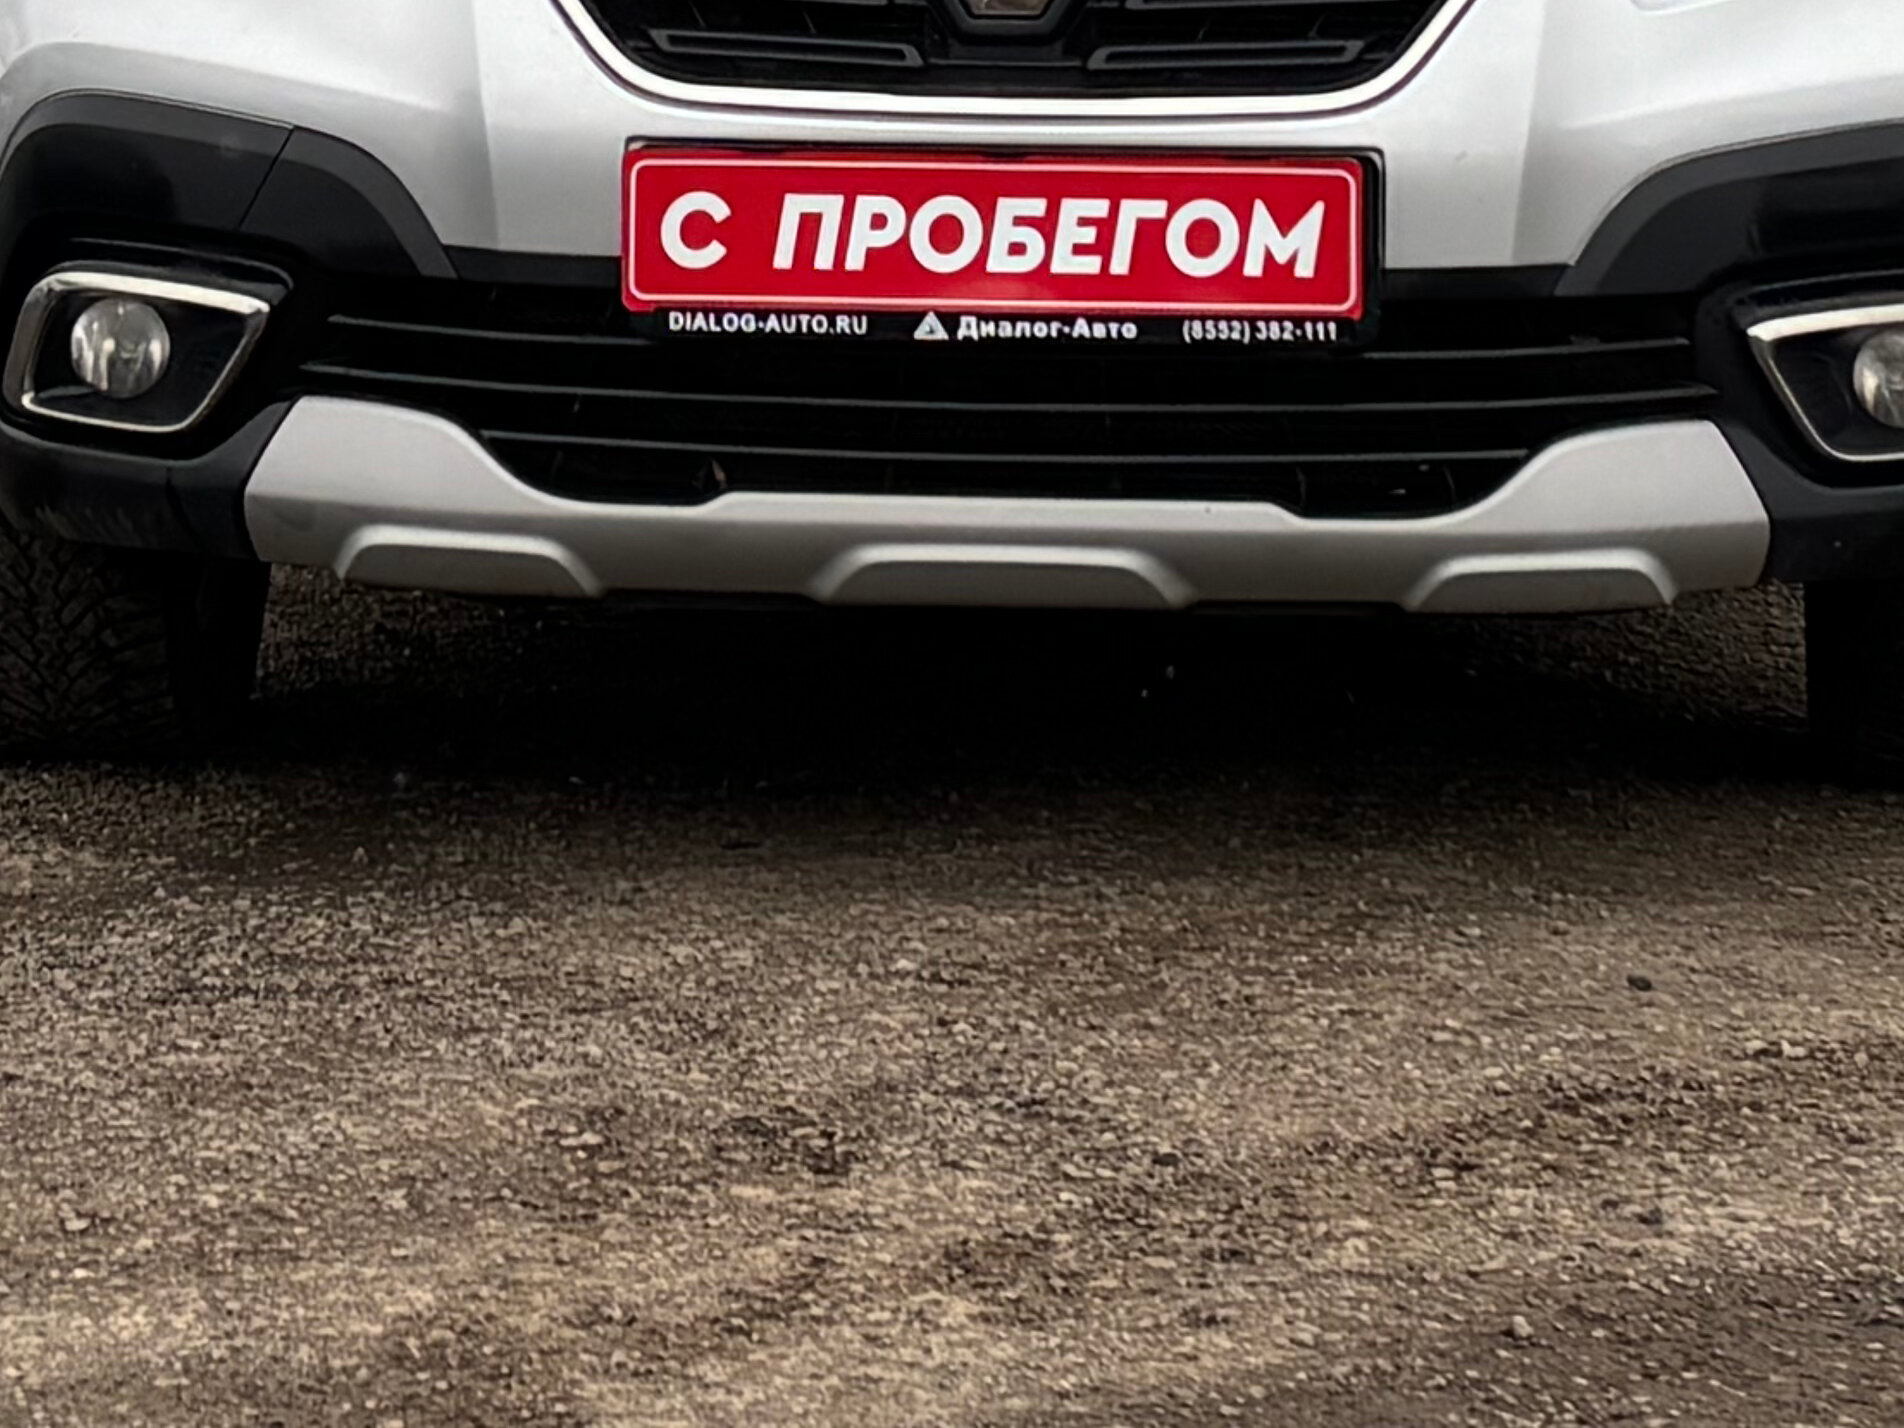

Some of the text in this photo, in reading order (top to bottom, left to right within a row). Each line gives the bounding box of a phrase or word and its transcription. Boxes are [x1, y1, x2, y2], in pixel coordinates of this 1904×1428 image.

[660, 190, 1325, 279] С ПРОБЕГОМ
[669, 310, 868, 335] DIALOG-AUTO.RU
[957, 315, 1138, 341] Диалог-Авто
